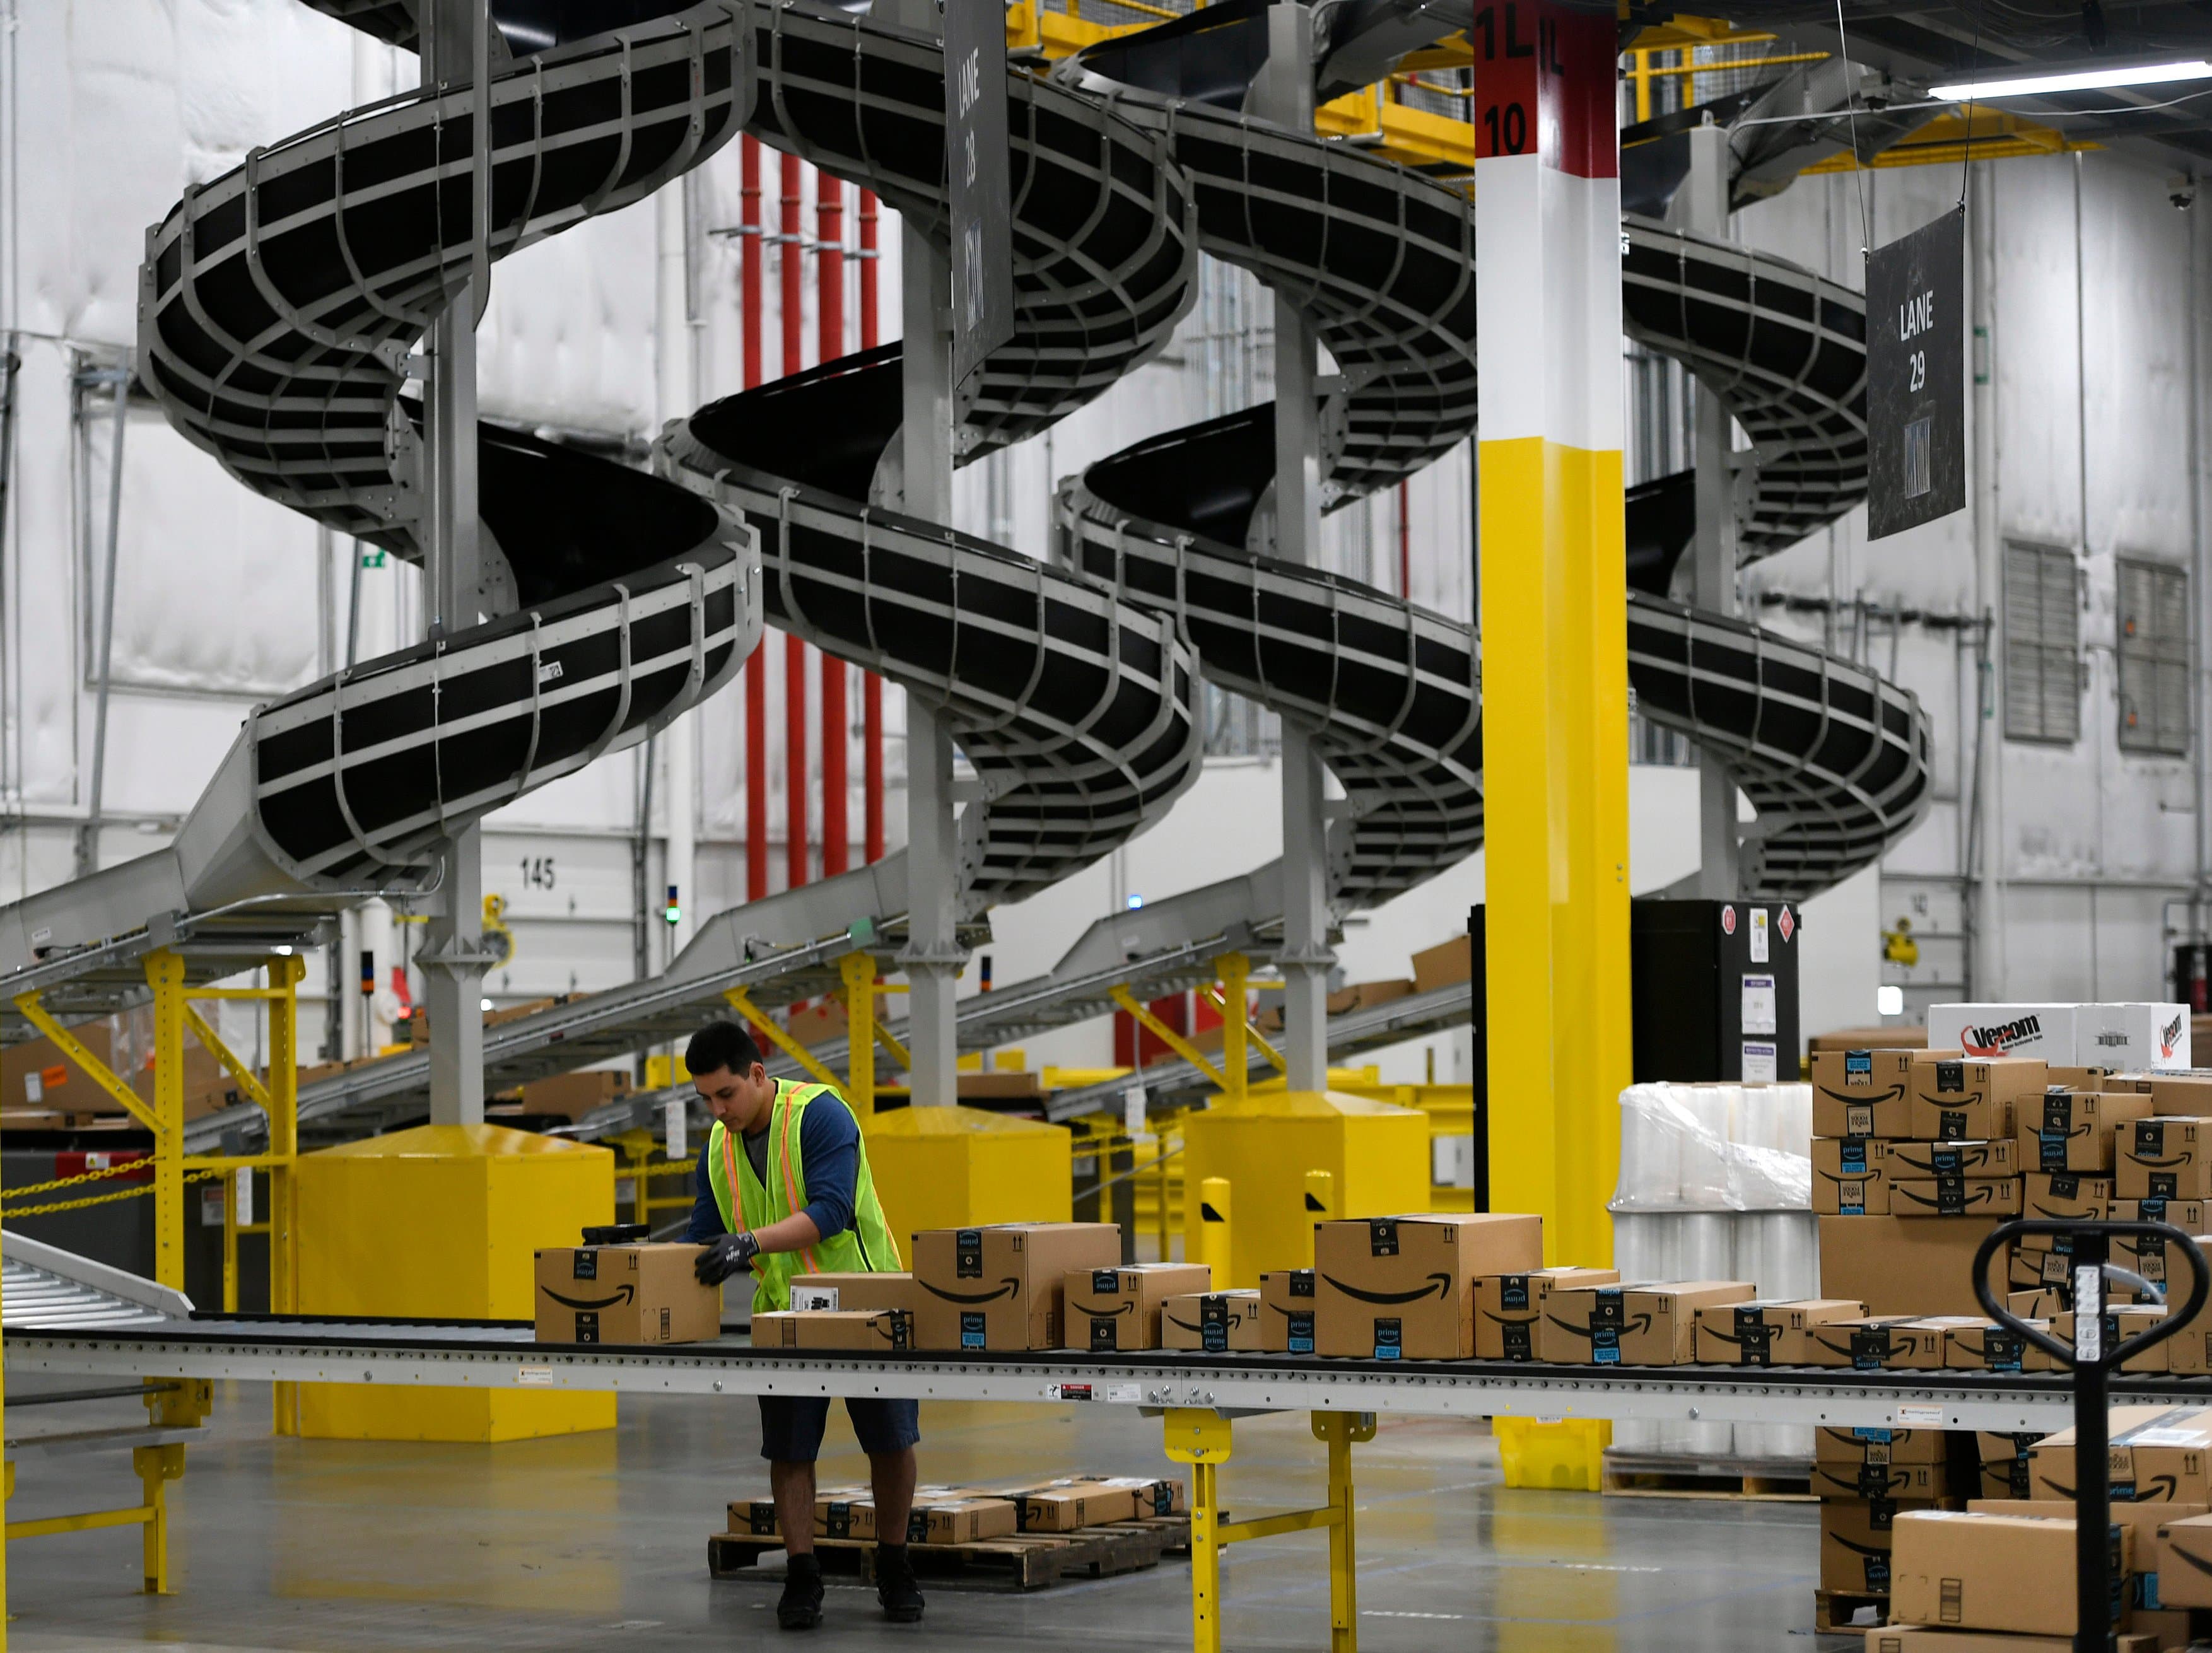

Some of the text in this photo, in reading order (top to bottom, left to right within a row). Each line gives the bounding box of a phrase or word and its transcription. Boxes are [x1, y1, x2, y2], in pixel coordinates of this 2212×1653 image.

[958, 46, 980, 120] LANE
[1485, 102, 1525, 156] 10
[966, 128, 976, 187] 28
[1900, 289, 1934, 341] LANE
[1909, 349, 1926, 393] 29
[520, 856, 555, 891] 145
[1972, 1015, 2041, 1049] Venom
[1843, 1145, 1863, 1154] prime
[2043, 1149, 2063, 1159] prime
[1935, 1155, 1955, 1164] prime
[2141, 1198, 2163, 1207] prime
[959, 1237, 978, 1246] prime
[1097, 1282, 1116, 1291] prime
[1504, 1294, 1525, 1304] prime
[964, 1316, 983, 1324] prime
[1290, 1320, 1312, 1329] prime
[1378, 1328, 1398, 1337] prime
[1595, 1331, 1615, 1340] prime
